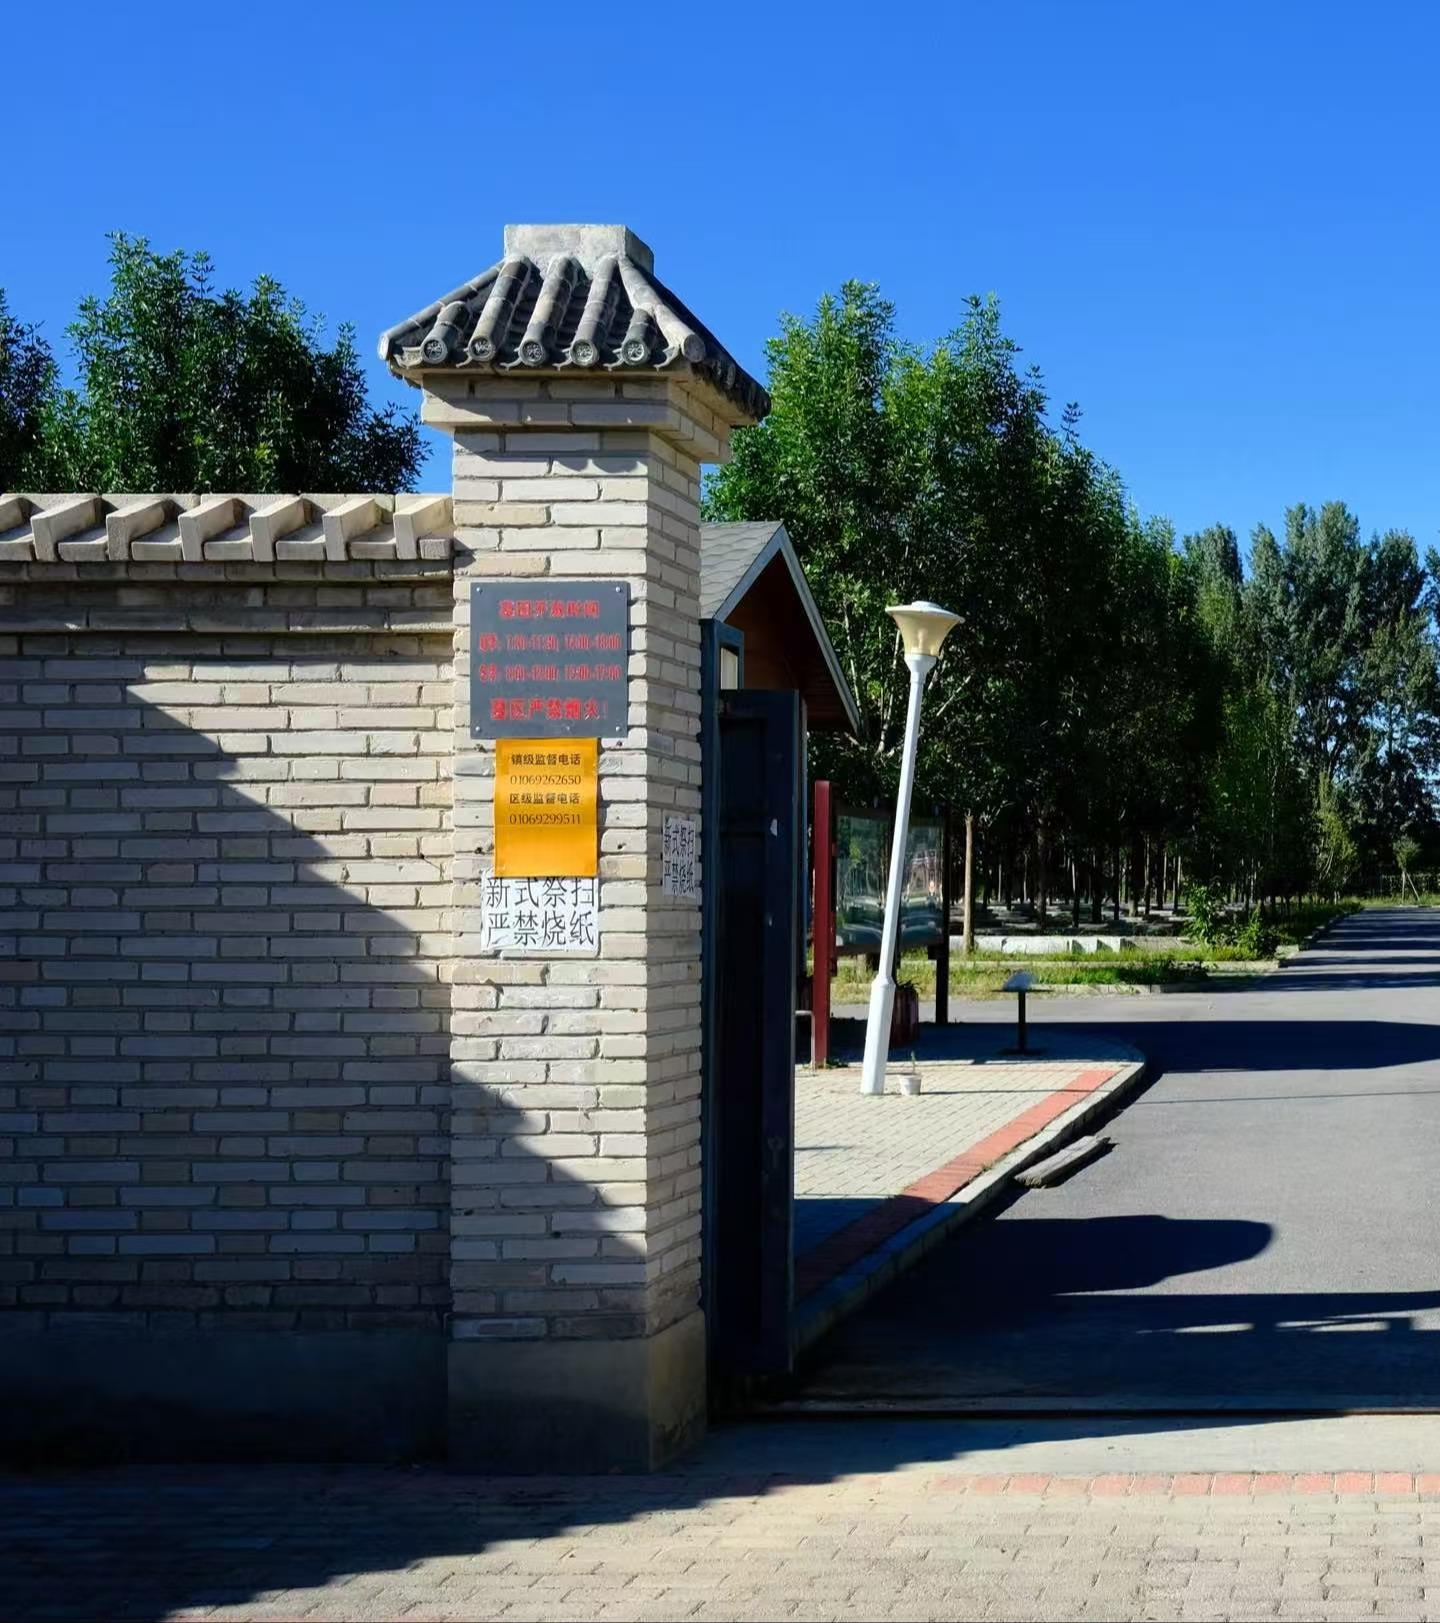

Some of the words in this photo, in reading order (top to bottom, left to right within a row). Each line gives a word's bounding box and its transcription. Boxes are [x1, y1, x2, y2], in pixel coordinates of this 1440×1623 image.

[511, 753, 581, 766] 镇级监督电话
[510, 775, 582, 785] 01069262650
[509, 792, 581, 805] 区级监督电话
[509, 813, 581, 825] 01069299511
[486, 878, 595, 908] 新式祭扫
[487, 910, 595, 947] 严禁烧纸
